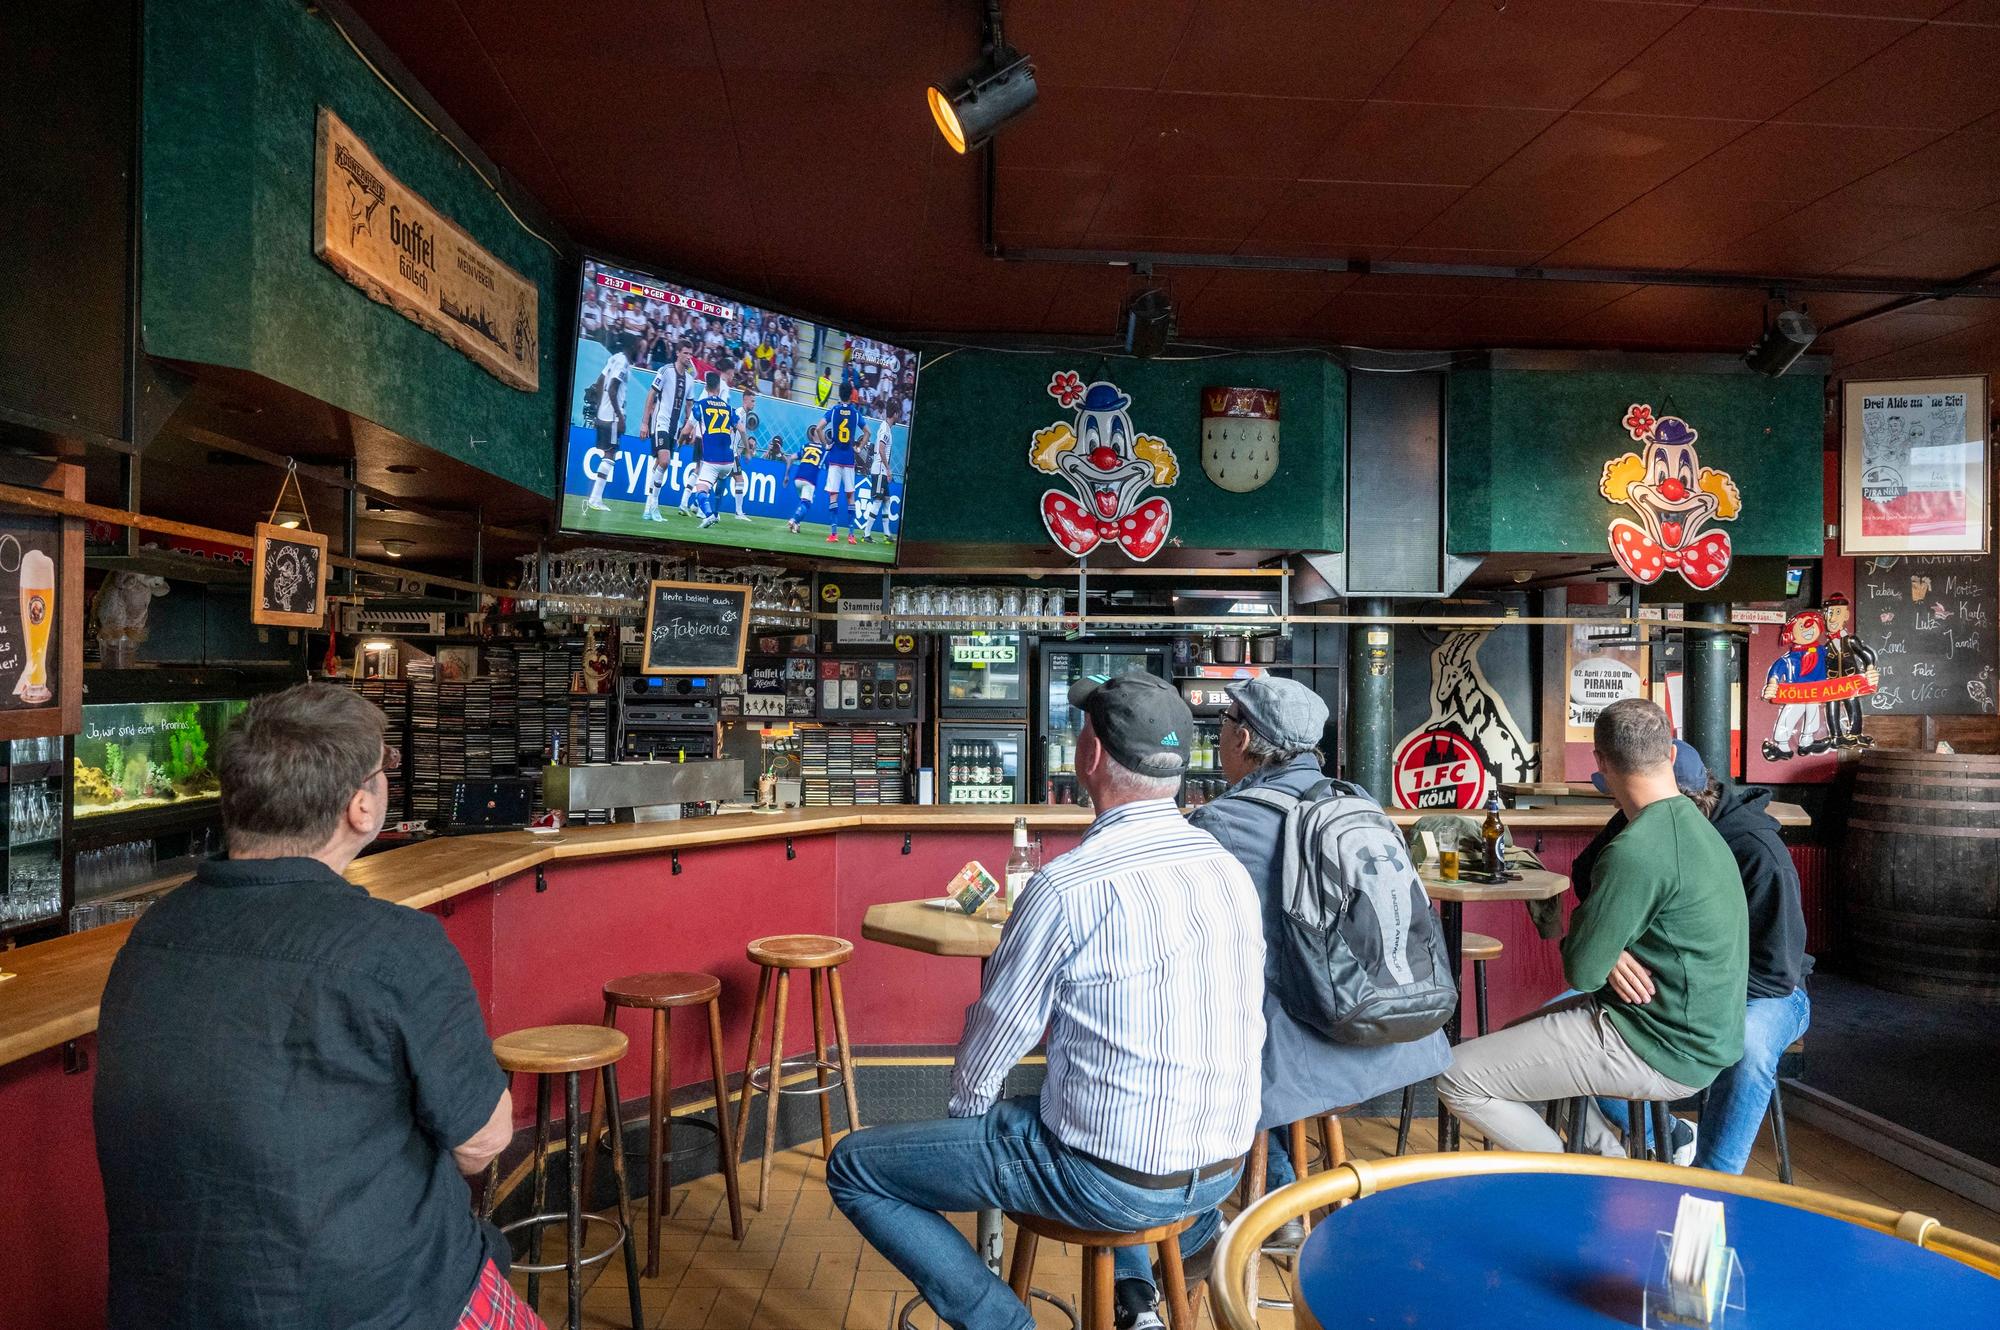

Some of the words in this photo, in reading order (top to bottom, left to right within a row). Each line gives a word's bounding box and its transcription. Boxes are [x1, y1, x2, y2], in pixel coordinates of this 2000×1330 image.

[390, 205, 436, 273] Gaffel
[399, 254, 428, 295] Kölsch
[457, 256, 474, 278] MEIN
[474, 266, 495, 292] VEREIN
[604, 277, 625, 289] 21:37
[650, 289, 665, 299] GER
[702, 303, 714, 313] JPN
[1863, 397, 1884, 409] Drei
[705, 407, 731, 434] 22
[838, 418, 850, 443] 6
[801, 446, 823, 465] 25
[1864, 487, 1900, 497] PIRANHA
[662, 591, 683, 602] Heute
[685, 593, 710, 604] bedient
[671, 616, 731, 640] Fabienne
[1915, 612, 1941, 630] Lutz
[754, 668, 778, 679] Gaffel
[1585, 669, 1599, 678] April
[1604, 670, 1621, 678] 20.00
[1912, 662, 1936, 677] Fabi
[1584, 678, 1623, 690] PIRANHA
[1779, 687, 1818, 699] KÖLLE
[1822, 679, 1861, 698] ALAAF
[1585, 690, 1606, 698] Eintritt
[118, 724, 135, 737] sind
[1413, 762, 1466, 790] 1.FC
[1418, 789, 1457, 808] KÖLN
[1390, 889, 1401, 927] UNDER
[1391, 928, 1403, 973] ARMOUR
